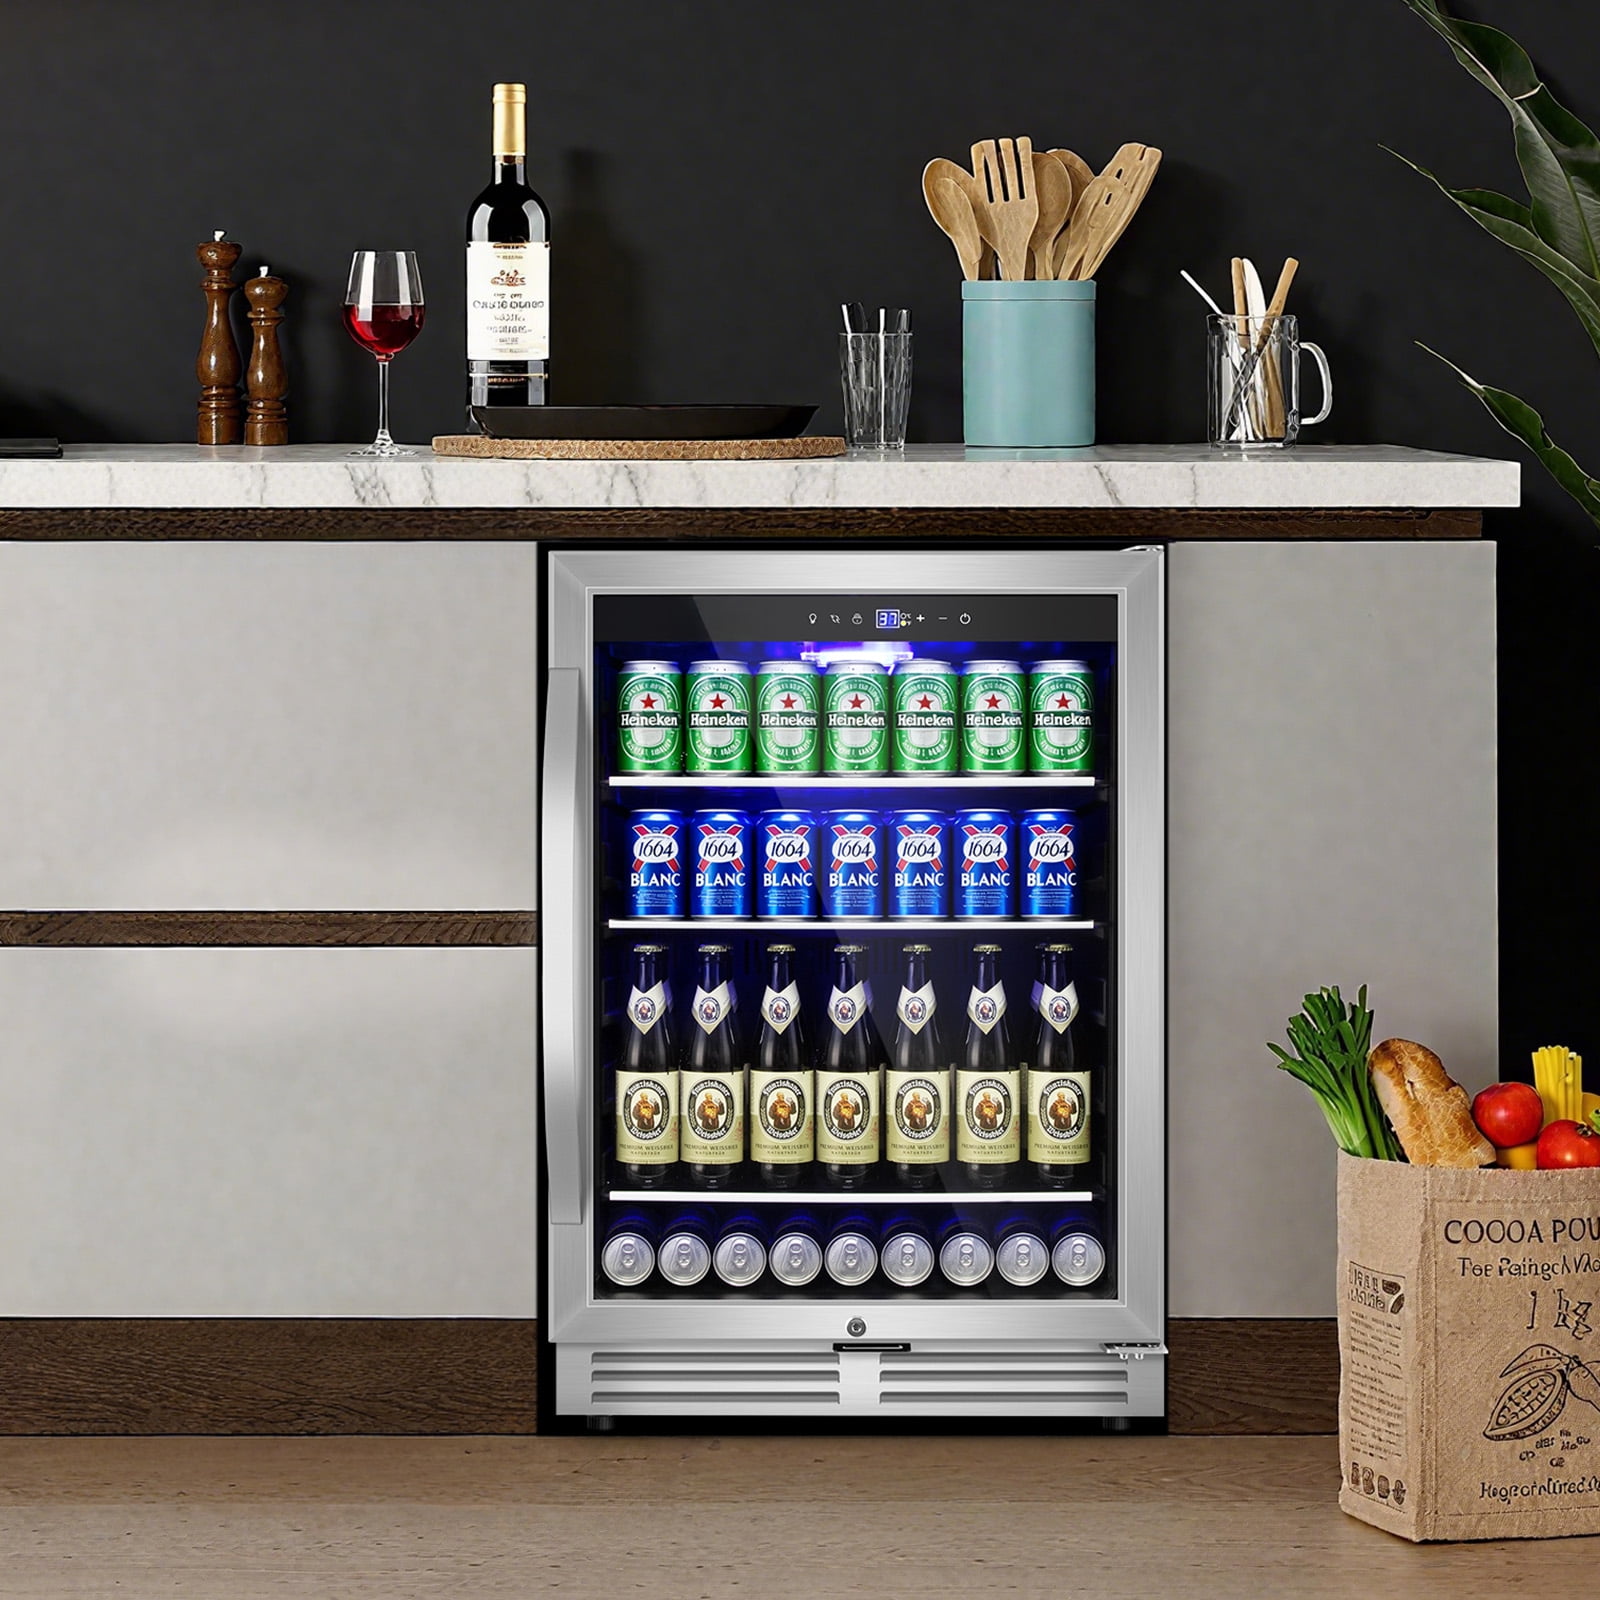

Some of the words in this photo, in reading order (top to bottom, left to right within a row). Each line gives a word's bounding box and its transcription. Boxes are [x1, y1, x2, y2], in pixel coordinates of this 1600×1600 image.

[880, 612, 898, 626] 37
[620, 713, 678, 727] Heineken
[690, 713, 748, 727] Heineken
[761, 713, 816, 727] Heineken
[828, 713, 885, 727] Heineken
[898, 713, 954, 727] Heineken
[966, 713, 1022, 727] Heineken
[1034, 713, 1092, 727] Heineken
[638, 839, 674, 858] 1664
[703, 839, 738, 858] 1664
[770, 839, 805, 858] 1664
[837, 839, 872, 858] 1664
[902, 839, 937, 858] 1664
[968, 839, 1003, 858] 1664
[1034, 839, 1070, 858] 1664
[630, 873, 681, 887] BLANC
[695, 873, 746, 887] BLANC
[763, 873, 813, 887] BLANC
[829, 873, 879, 887] BLANC
[894, 873, 945, 887] BLANC
[961, 873, 1011, 887] BLANC
[1026, 873, 1077, 887] BLANC
